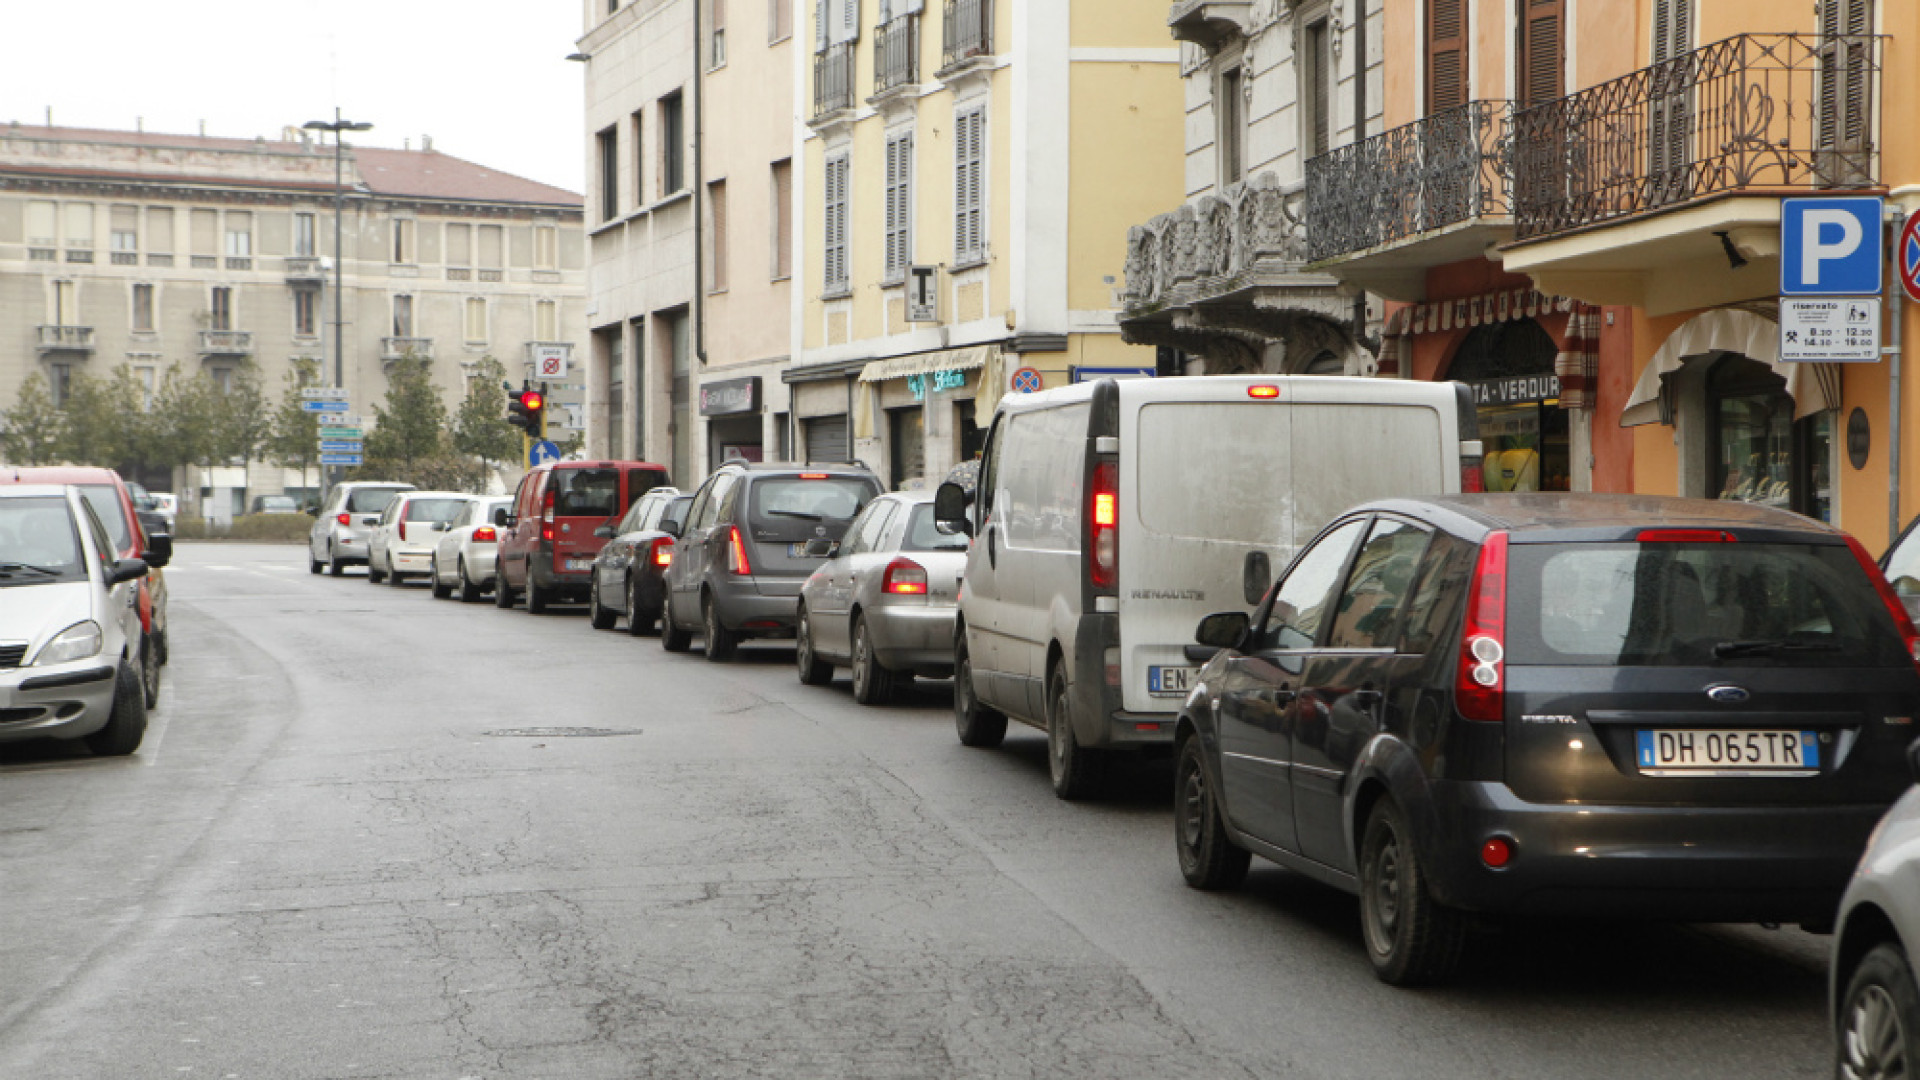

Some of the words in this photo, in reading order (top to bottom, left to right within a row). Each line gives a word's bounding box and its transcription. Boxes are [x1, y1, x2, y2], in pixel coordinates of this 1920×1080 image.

[1802, 208, 1863, 285] P
[912, 267, 933, 305] T
[1499, 376, 1560, 401] VERDUR
